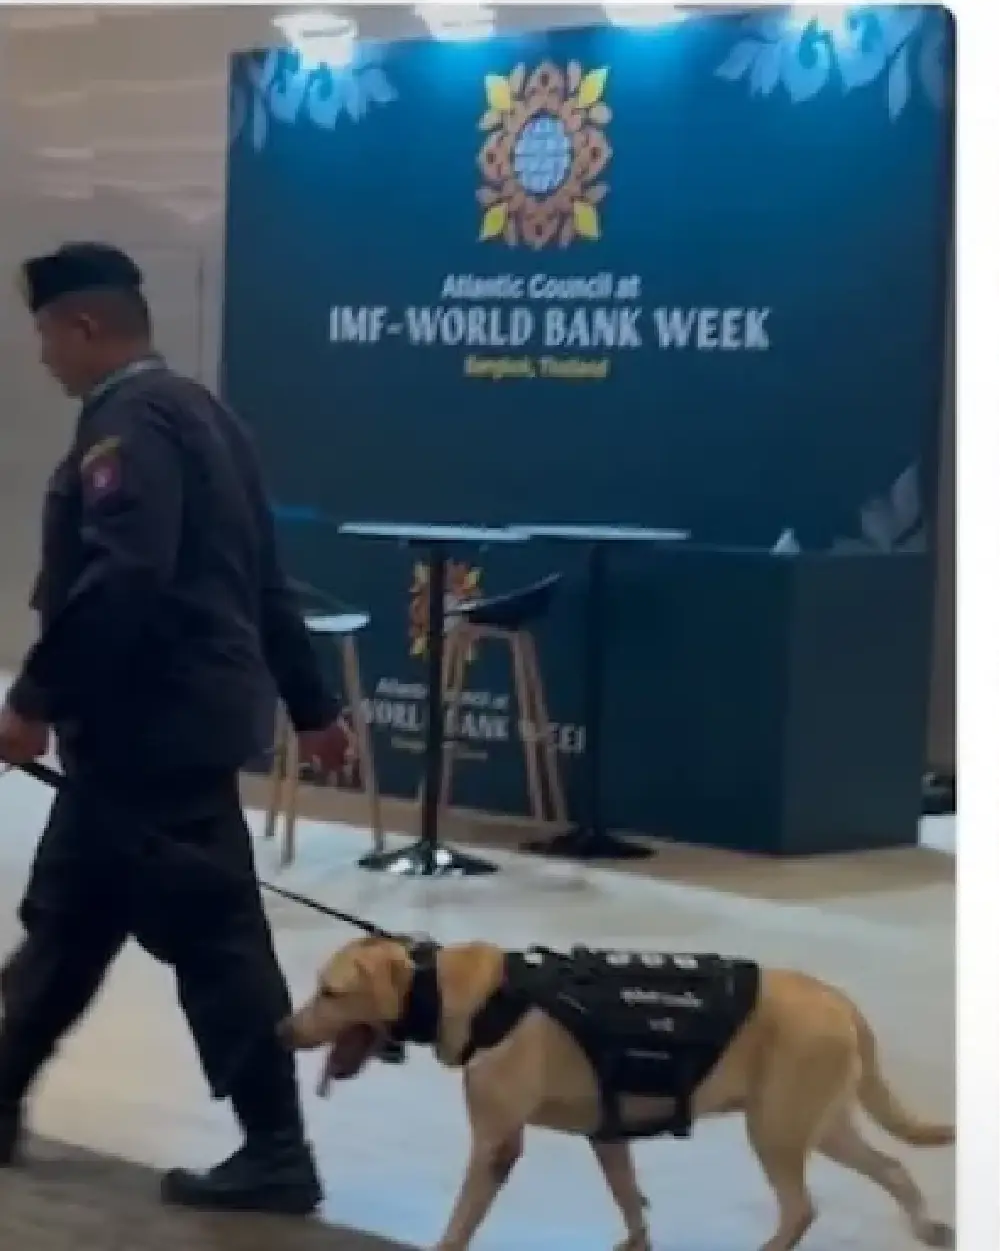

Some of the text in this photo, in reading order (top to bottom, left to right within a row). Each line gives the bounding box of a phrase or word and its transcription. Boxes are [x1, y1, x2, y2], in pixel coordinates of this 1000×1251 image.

[441, 272, 641, 299] Atlantic Council at
[329, 305, 772, 349] IMF-WORLD BANK WEEK
